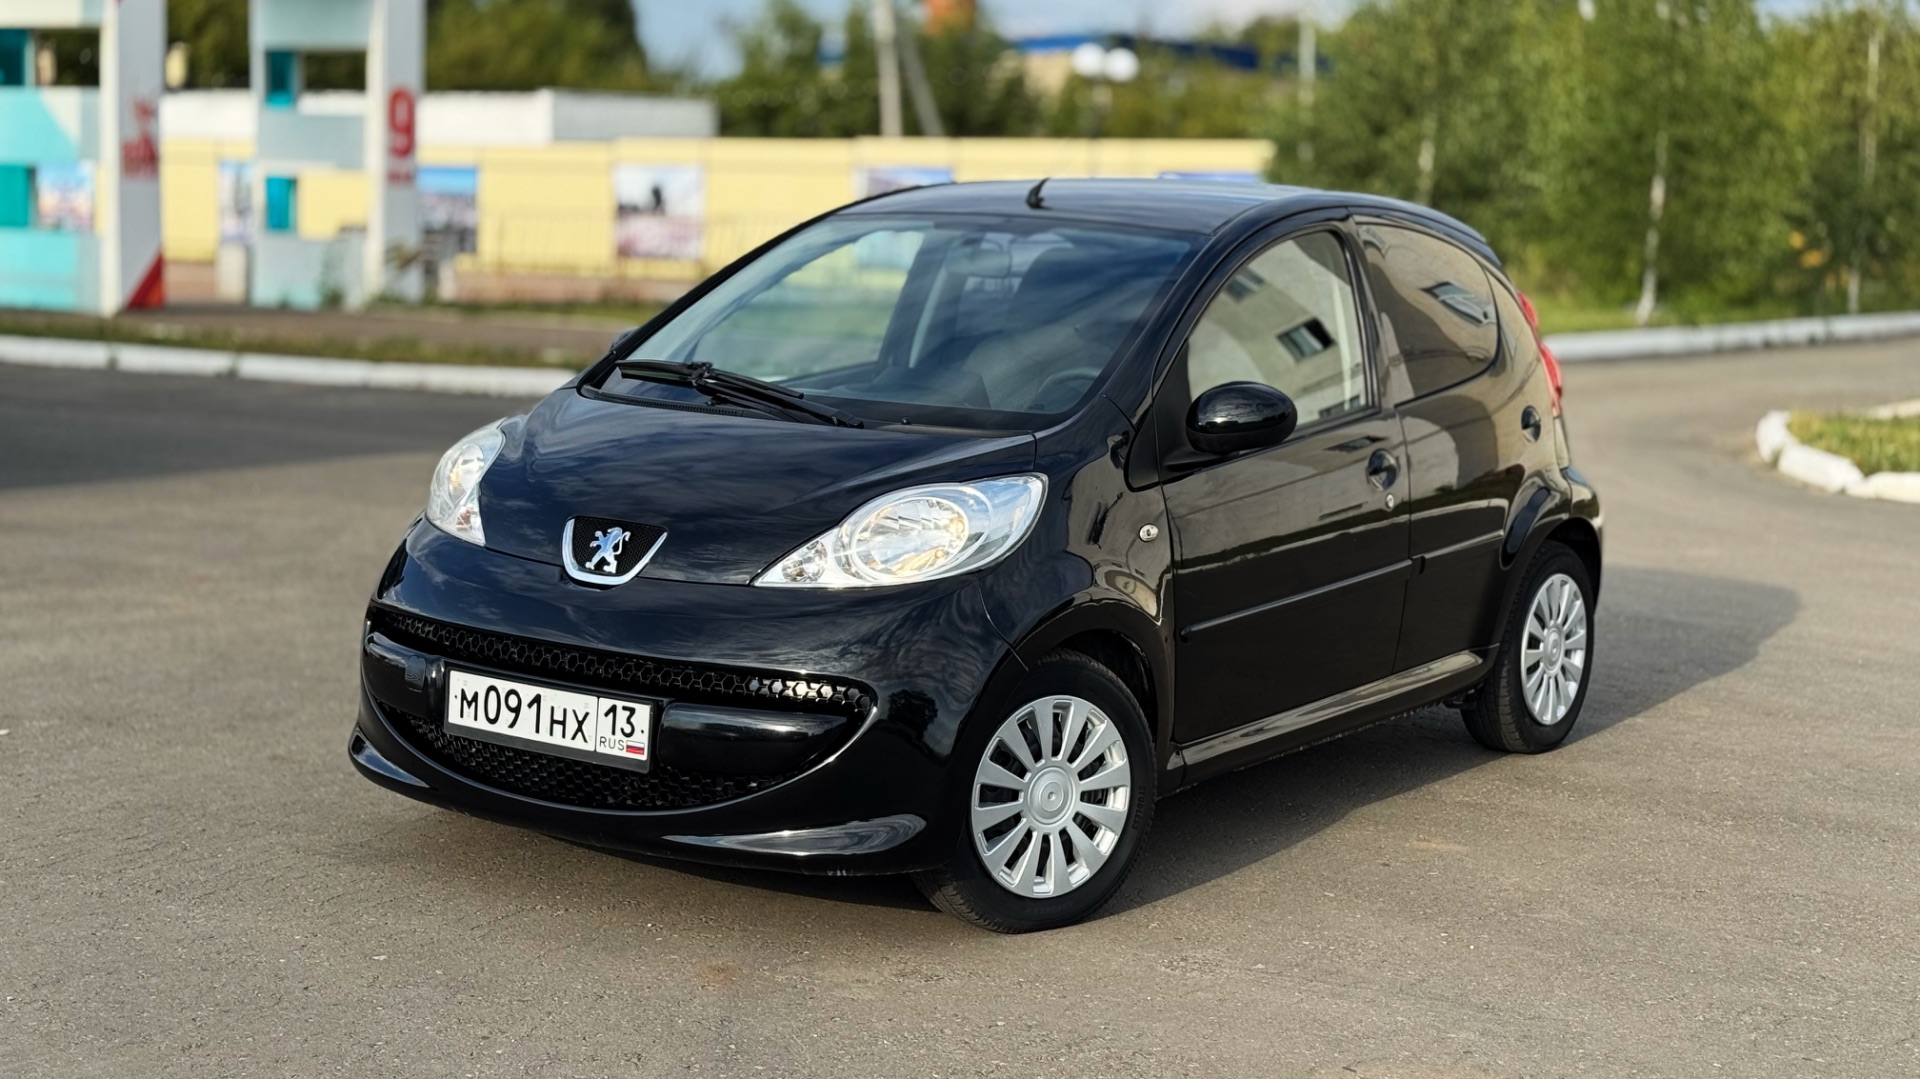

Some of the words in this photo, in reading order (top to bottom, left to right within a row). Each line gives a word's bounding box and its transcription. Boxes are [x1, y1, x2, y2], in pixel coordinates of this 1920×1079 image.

[389, 87, 415, 157] 9
[604, 704, 636, 738] 13
[599, 736, 625, 751] RUS
